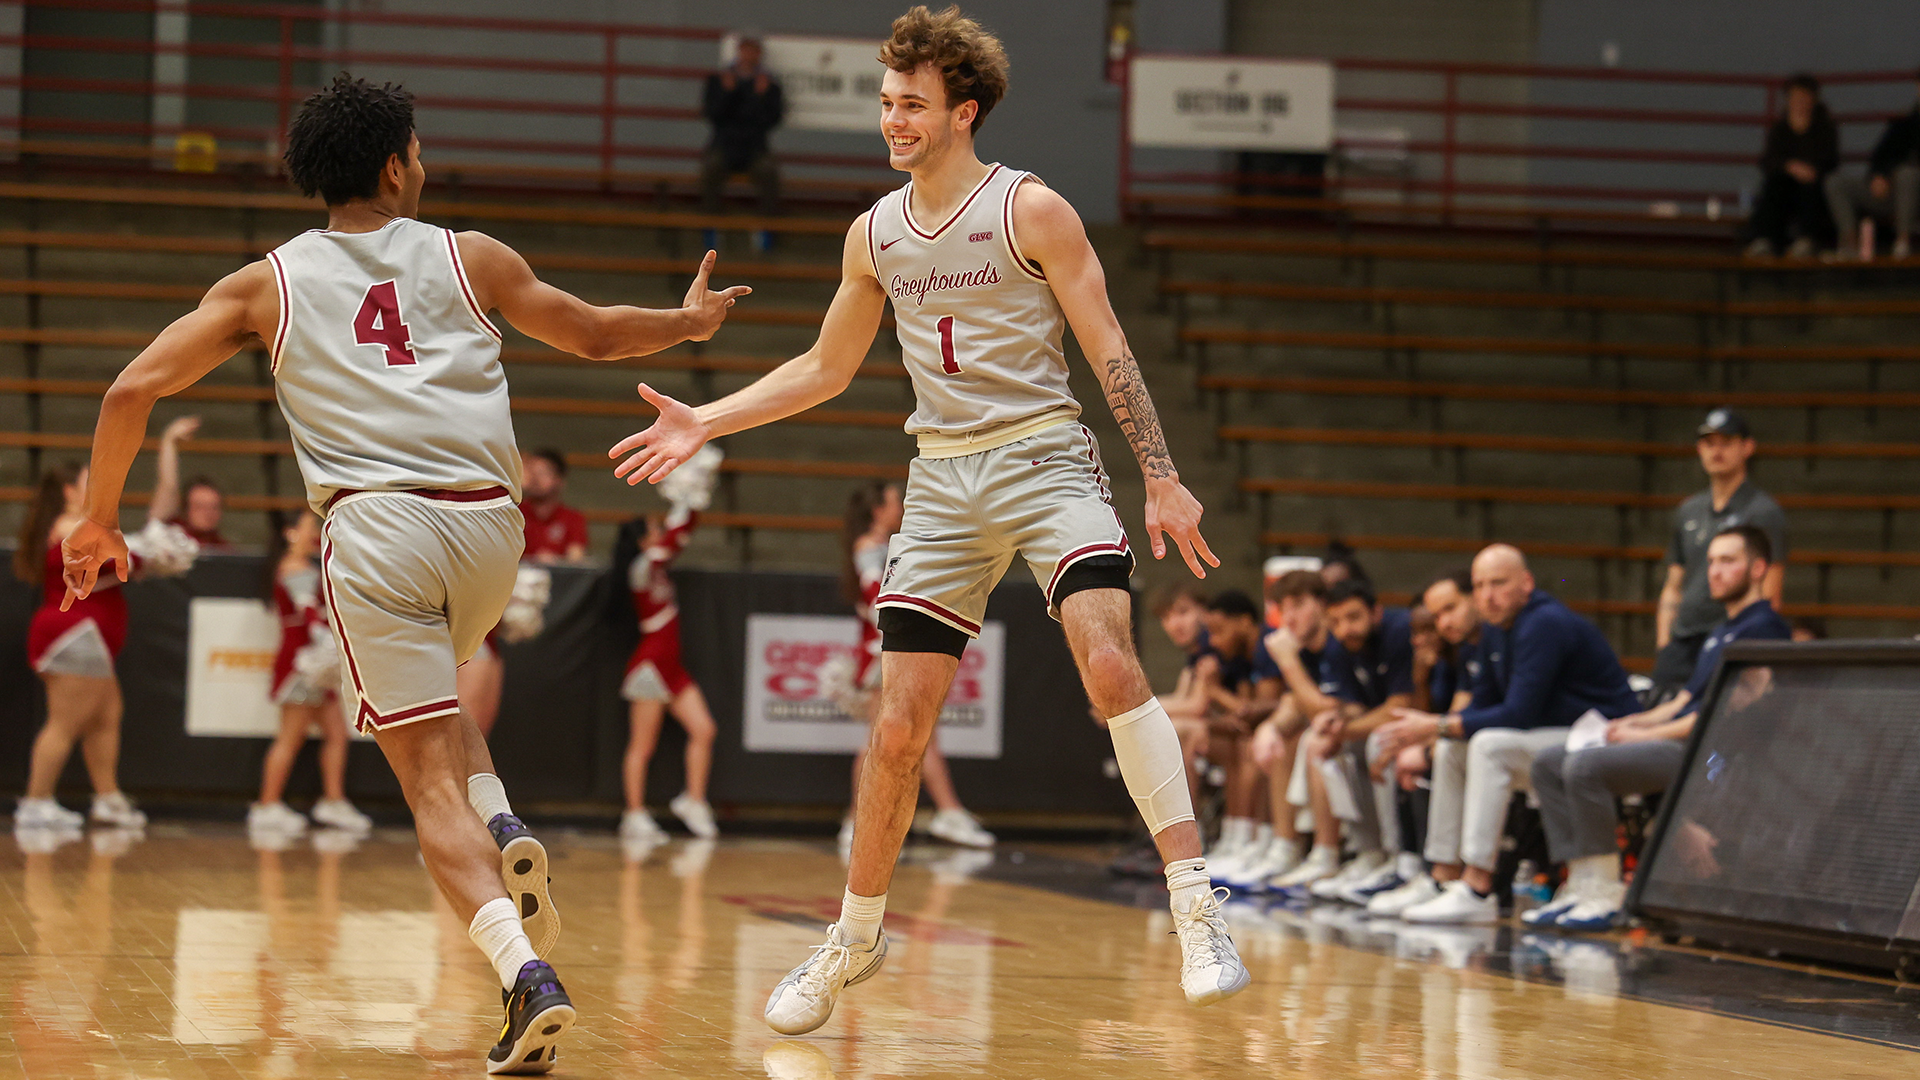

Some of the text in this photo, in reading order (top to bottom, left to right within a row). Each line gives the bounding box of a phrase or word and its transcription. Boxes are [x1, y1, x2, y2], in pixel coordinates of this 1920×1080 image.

[967, 231, 994, 243] GLVC
[891, 260, 1001, 306] Greyhounds
[351, 278, 419, 368] 4
[935, 314, 964, 374] 1
